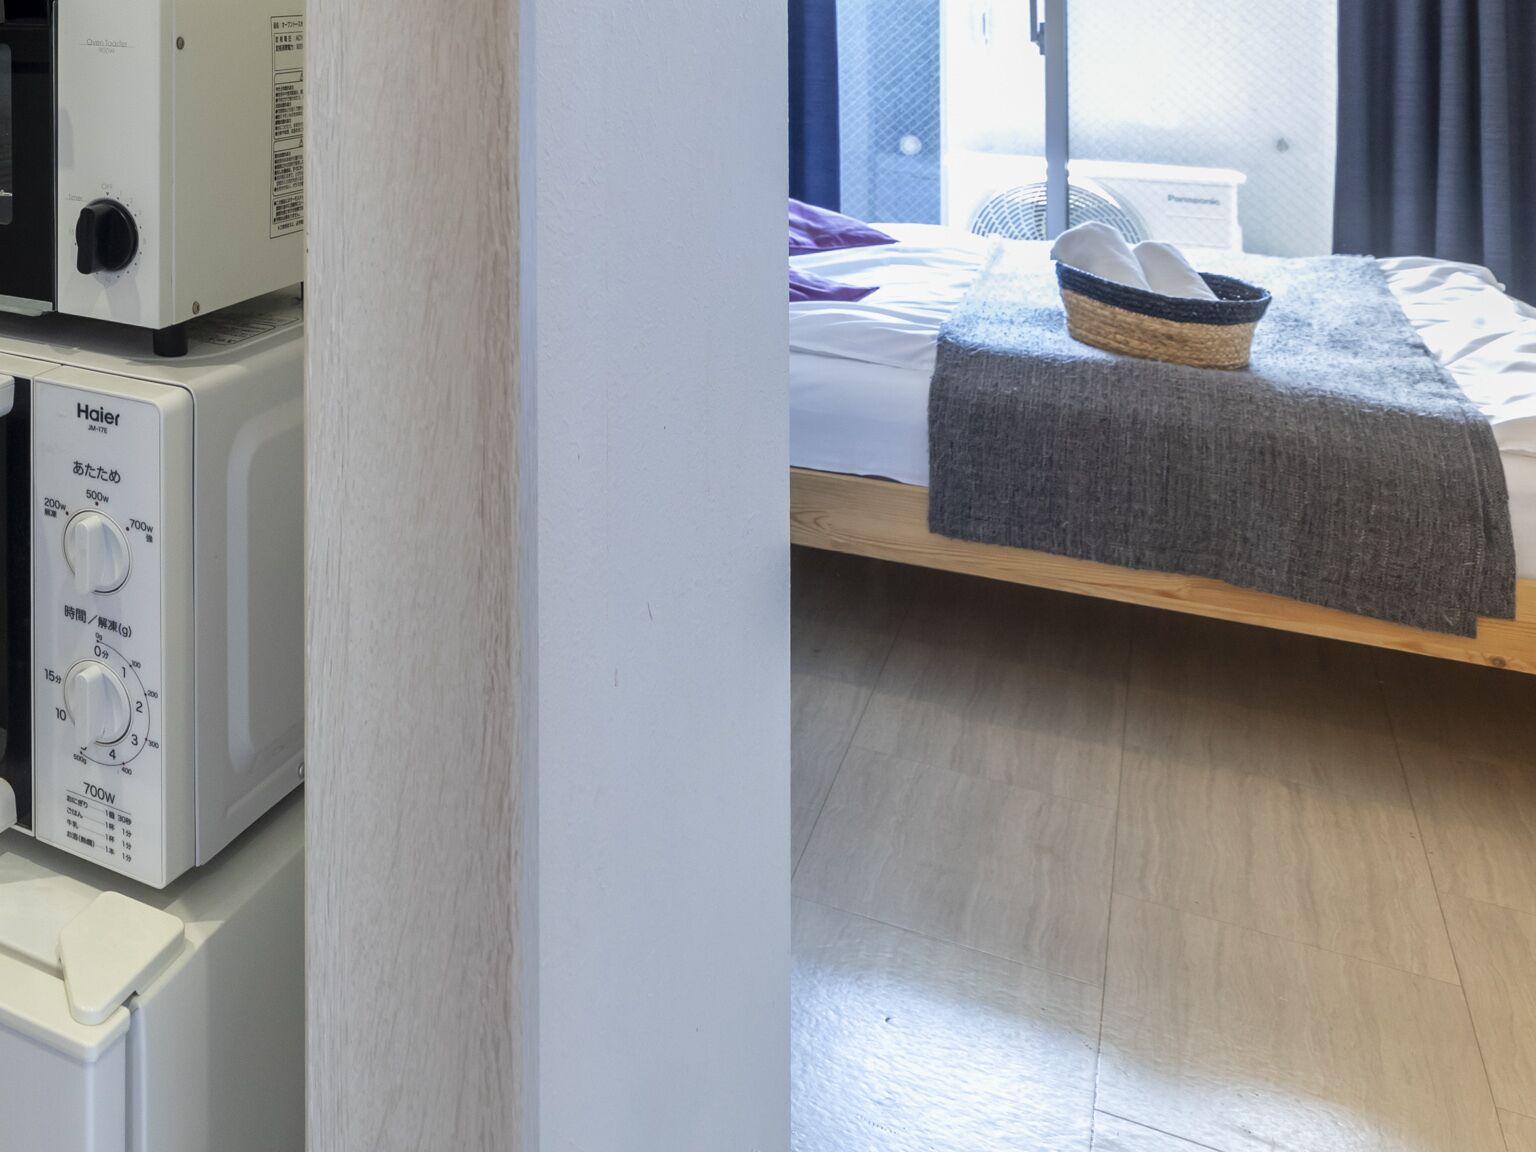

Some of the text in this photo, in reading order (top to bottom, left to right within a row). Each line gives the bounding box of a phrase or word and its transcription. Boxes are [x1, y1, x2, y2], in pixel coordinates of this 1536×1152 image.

[1167, 193, 1221, 207] Panasonic
[76, 402, 120, 426] Haier
[72, 460, 121, 485] あたため
[93, 645, 110, 660] 0分
[44, 668, 62, 685] 15分
[121, 666, 126, 679] 1
[147, 689, 159, 699] 200
[55, 707, 67, 721] 10
[135, 700, 143, 714] 2
[130, 733, 139, 746] 3
[108, 748, 116, 760] 4
[82, 781, 116, 805] 700W
